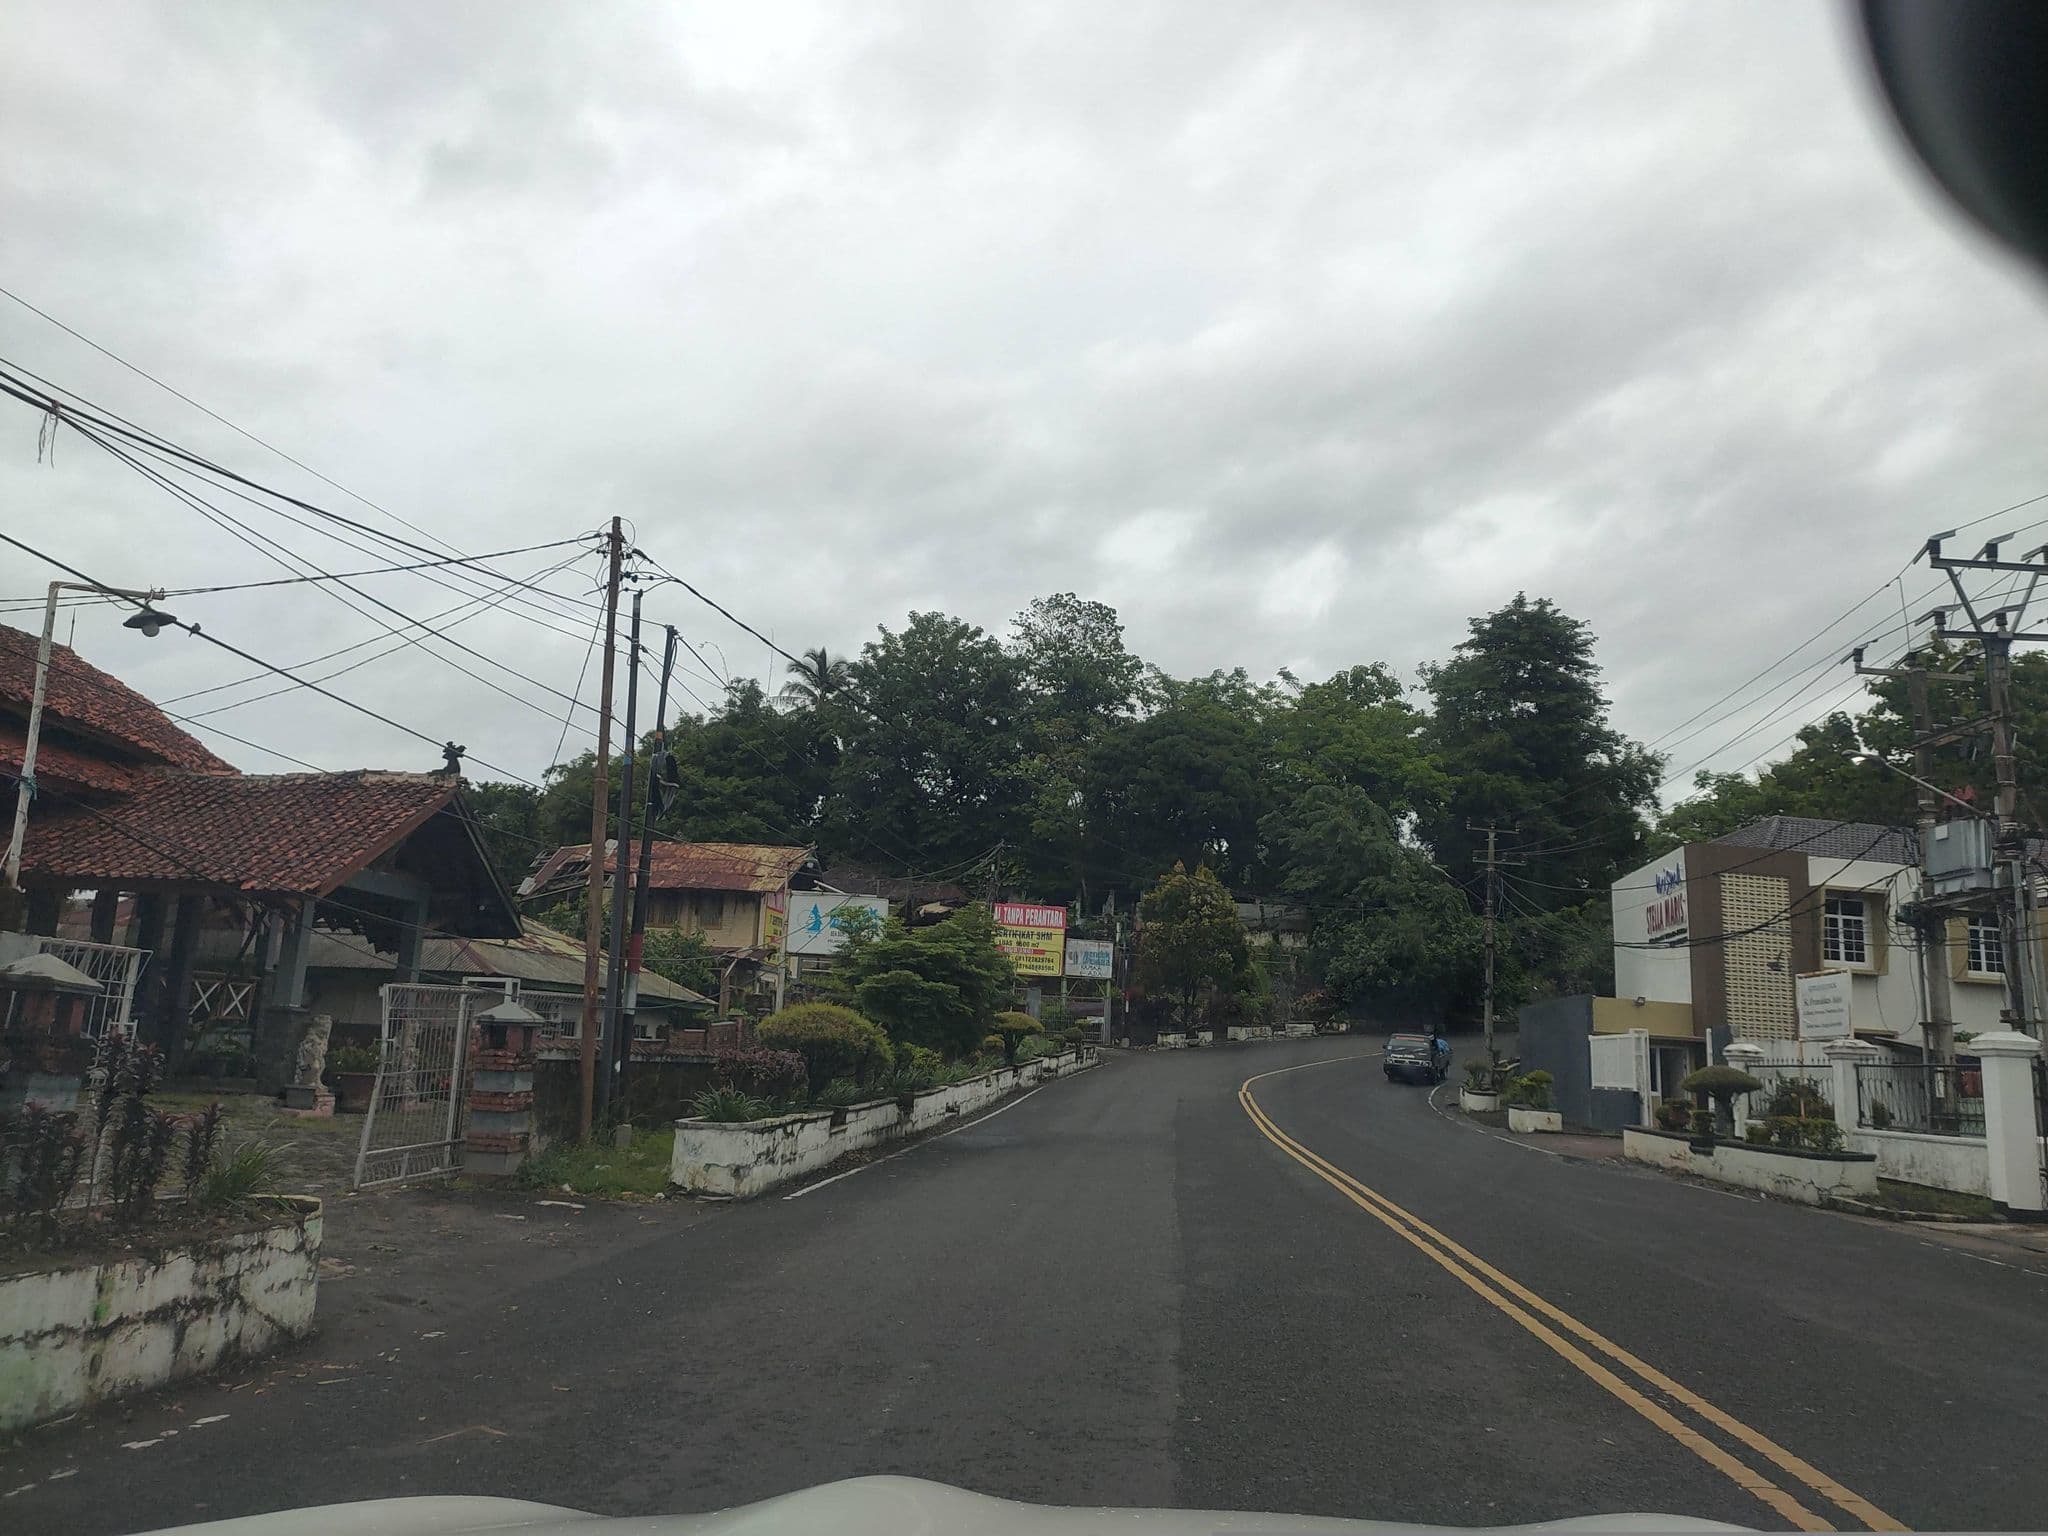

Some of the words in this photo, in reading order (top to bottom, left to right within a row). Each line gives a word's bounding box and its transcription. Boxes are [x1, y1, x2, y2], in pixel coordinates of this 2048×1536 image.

[1004, 907, 1024, 925] TANPA
[1025, 909, 1063, 927] PERANTARA
[1647, 901, 1664, 935] STELLA
[1665, 892, 1684, 928] MARIS
[1036, 931, 1052, 941] SHM
